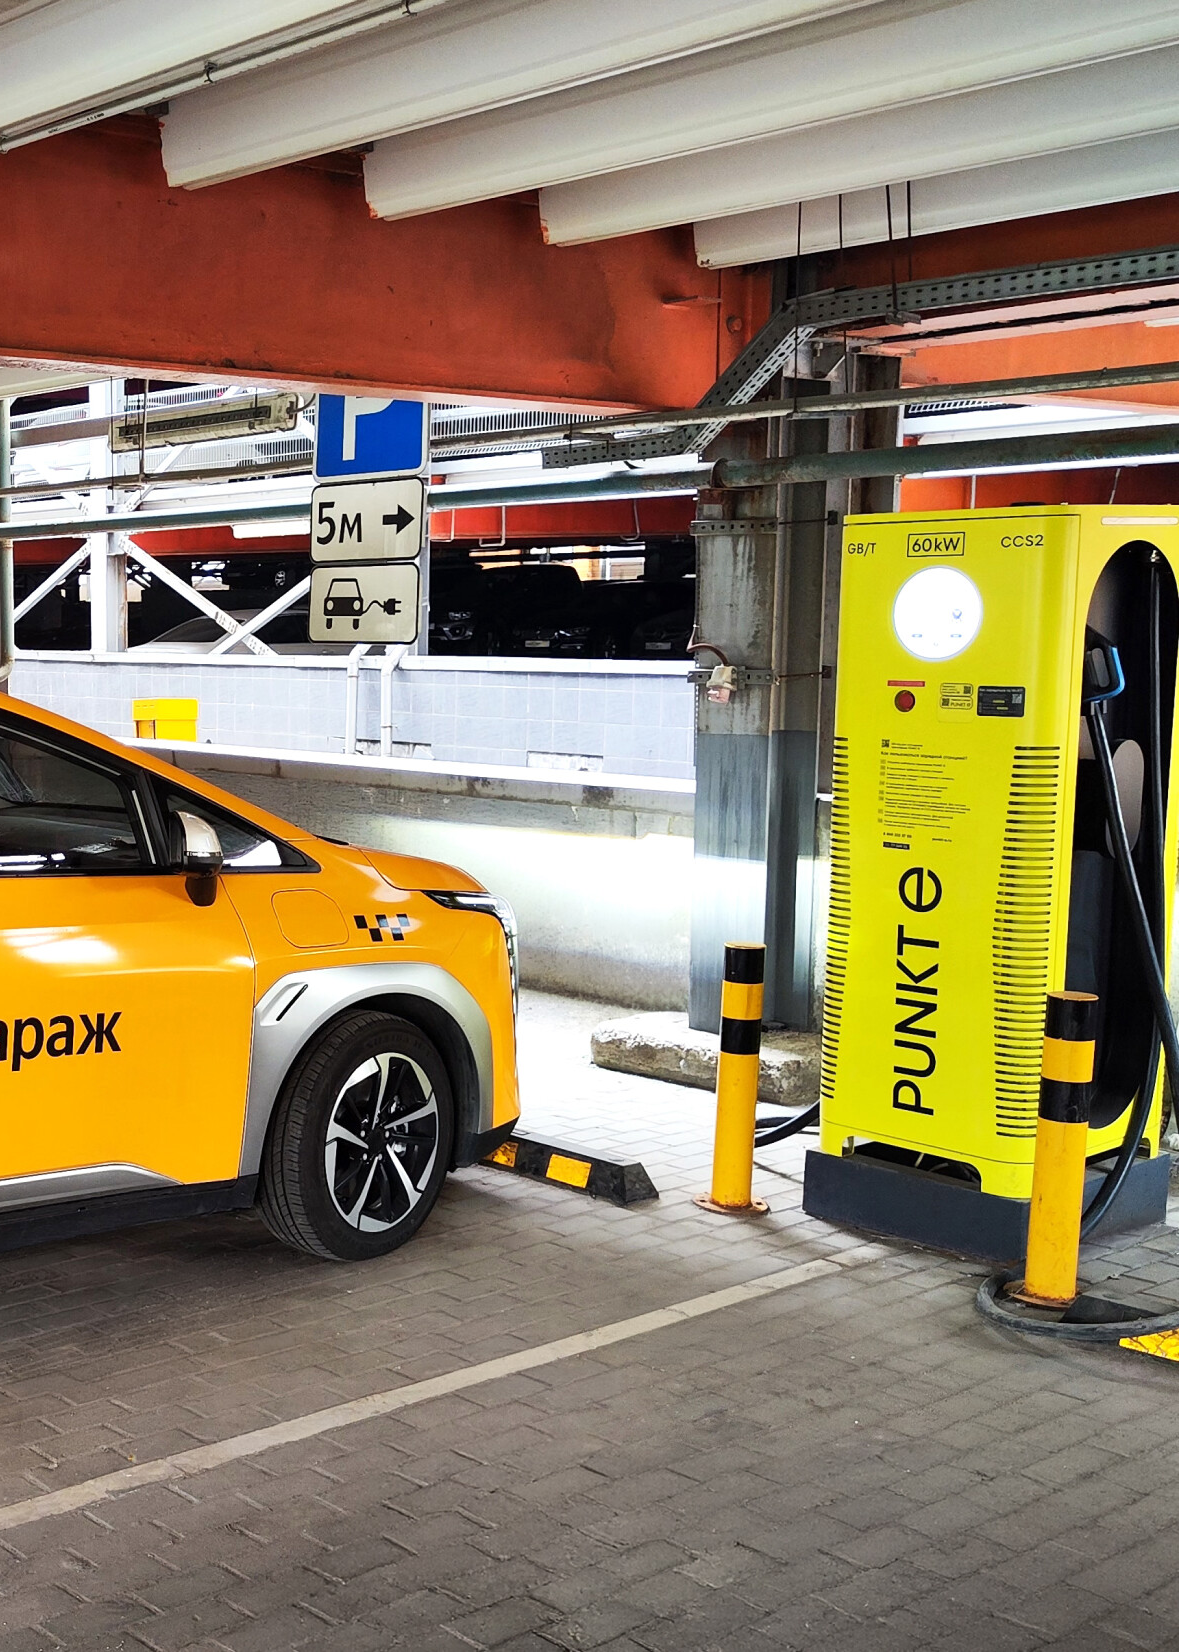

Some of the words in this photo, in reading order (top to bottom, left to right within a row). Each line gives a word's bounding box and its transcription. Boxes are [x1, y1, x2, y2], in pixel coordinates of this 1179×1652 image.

[1000, 534, 1044, 549] CCS2
[847, 542, 877, 557] GB/T
[893, 924, 940, 1116] PUNKT
